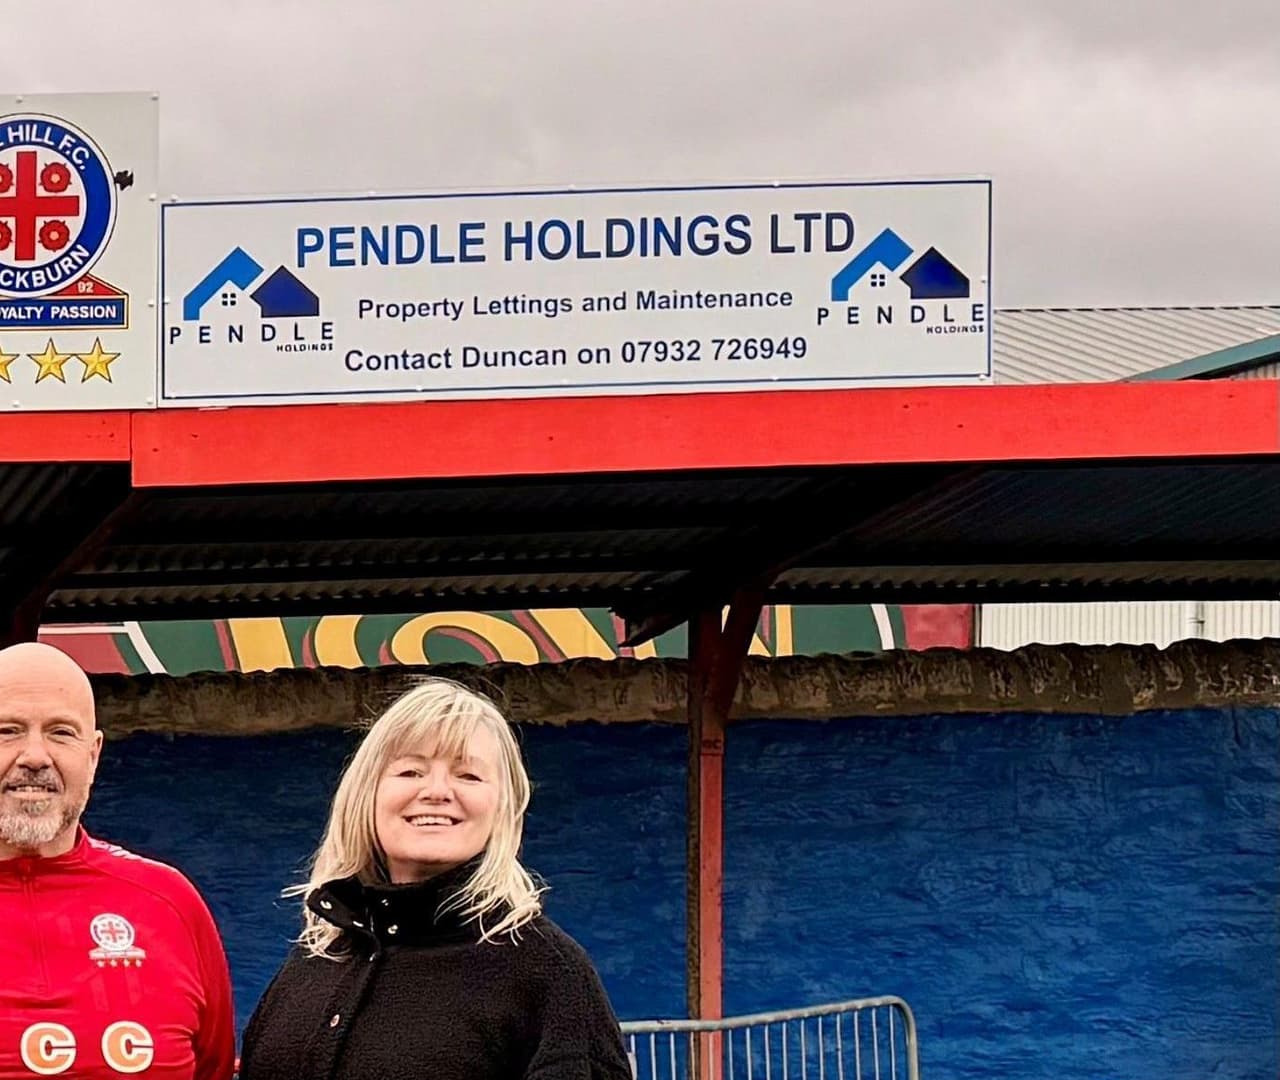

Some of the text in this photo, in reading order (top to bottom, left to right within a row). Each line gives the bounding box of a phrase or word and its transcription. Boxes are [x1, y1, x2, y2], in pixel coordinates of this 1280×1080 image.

[7, 124, 55, 146] HILL
[59, 139, 90, 171] F.C.
[297, 212, 855, 268] PENDLE HOLDINGS LTD
[50, 305, 117, 319] PASSION
[359, 289, 793, 323] Property Lettings and Maintenance
[926, 325, 984, 334] HOLDINGS
[276, 343, 334, 352] HOLDINGS
[344, 336, 807, 372] Contact Duncan on 07932 726949
